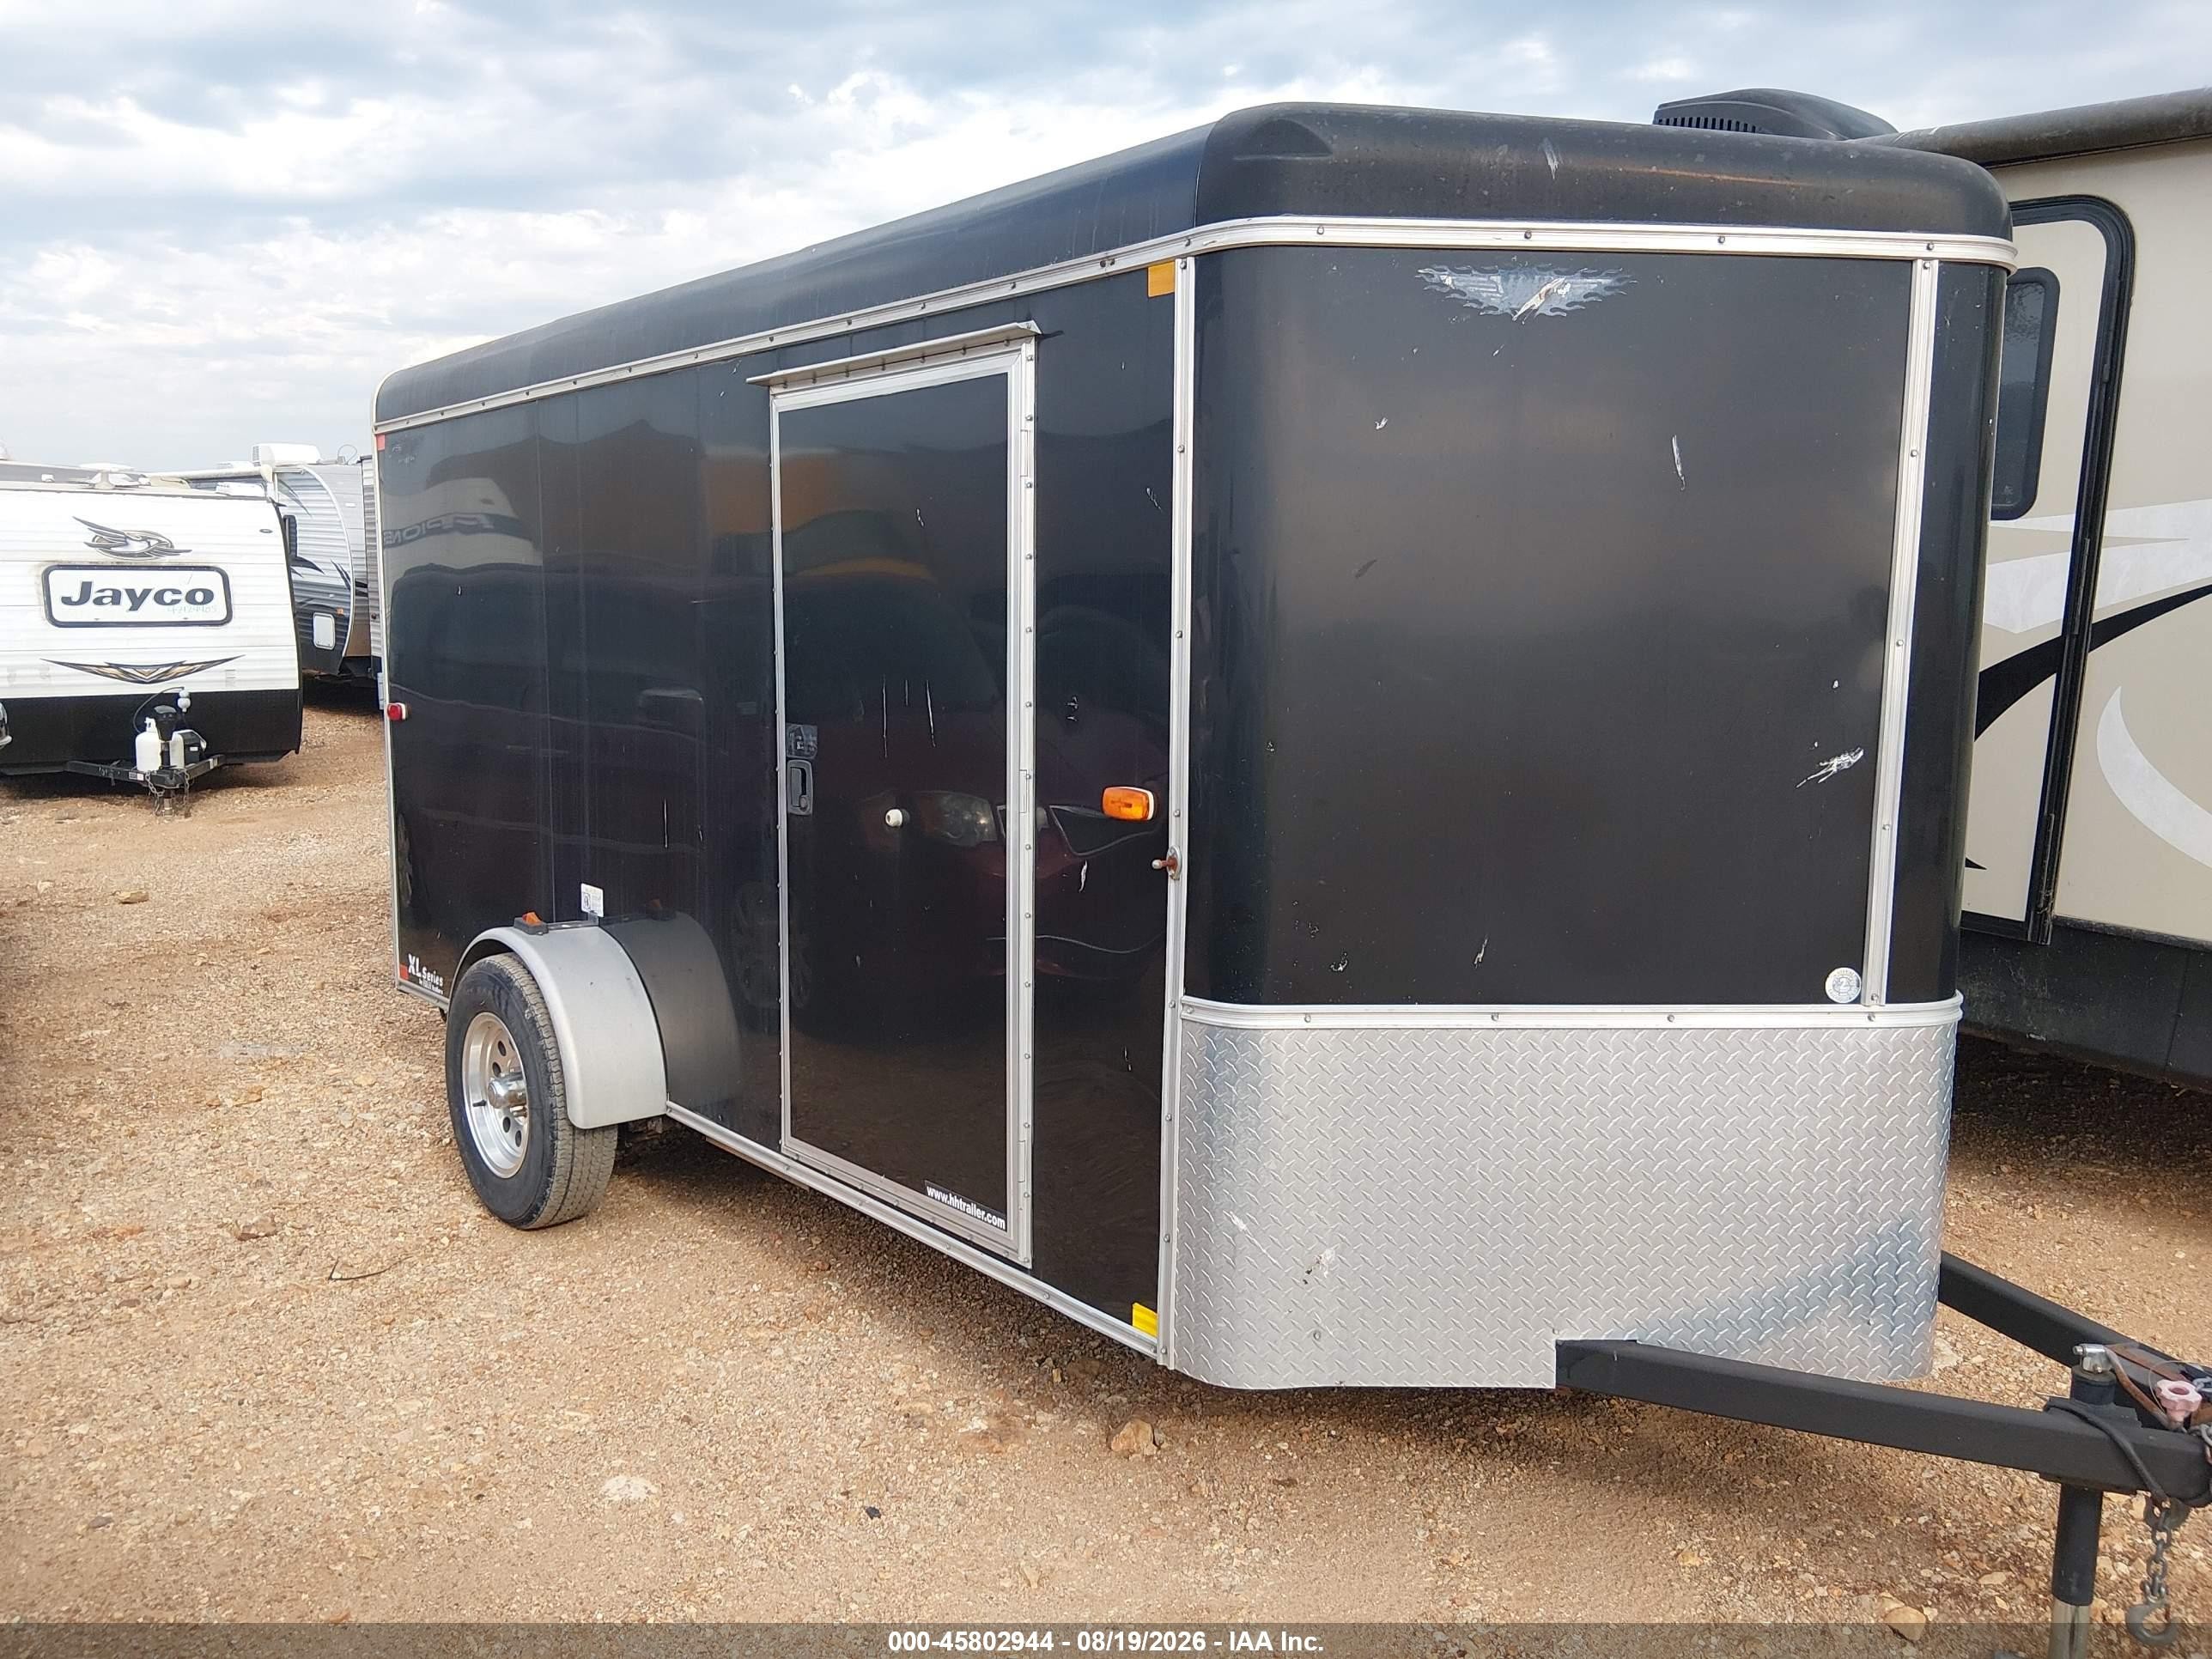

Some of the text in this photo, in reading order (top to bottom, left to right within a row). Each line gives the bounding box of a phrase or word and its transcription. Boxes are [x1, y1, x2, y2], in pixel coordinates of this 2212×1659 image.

[61, 580, 215, 612] Jayco
[408, 953, 422, 978] XL
[422, 966, 444, 988] Series
[927, 1185, 1006, 1231] www.hhtrailer.com
